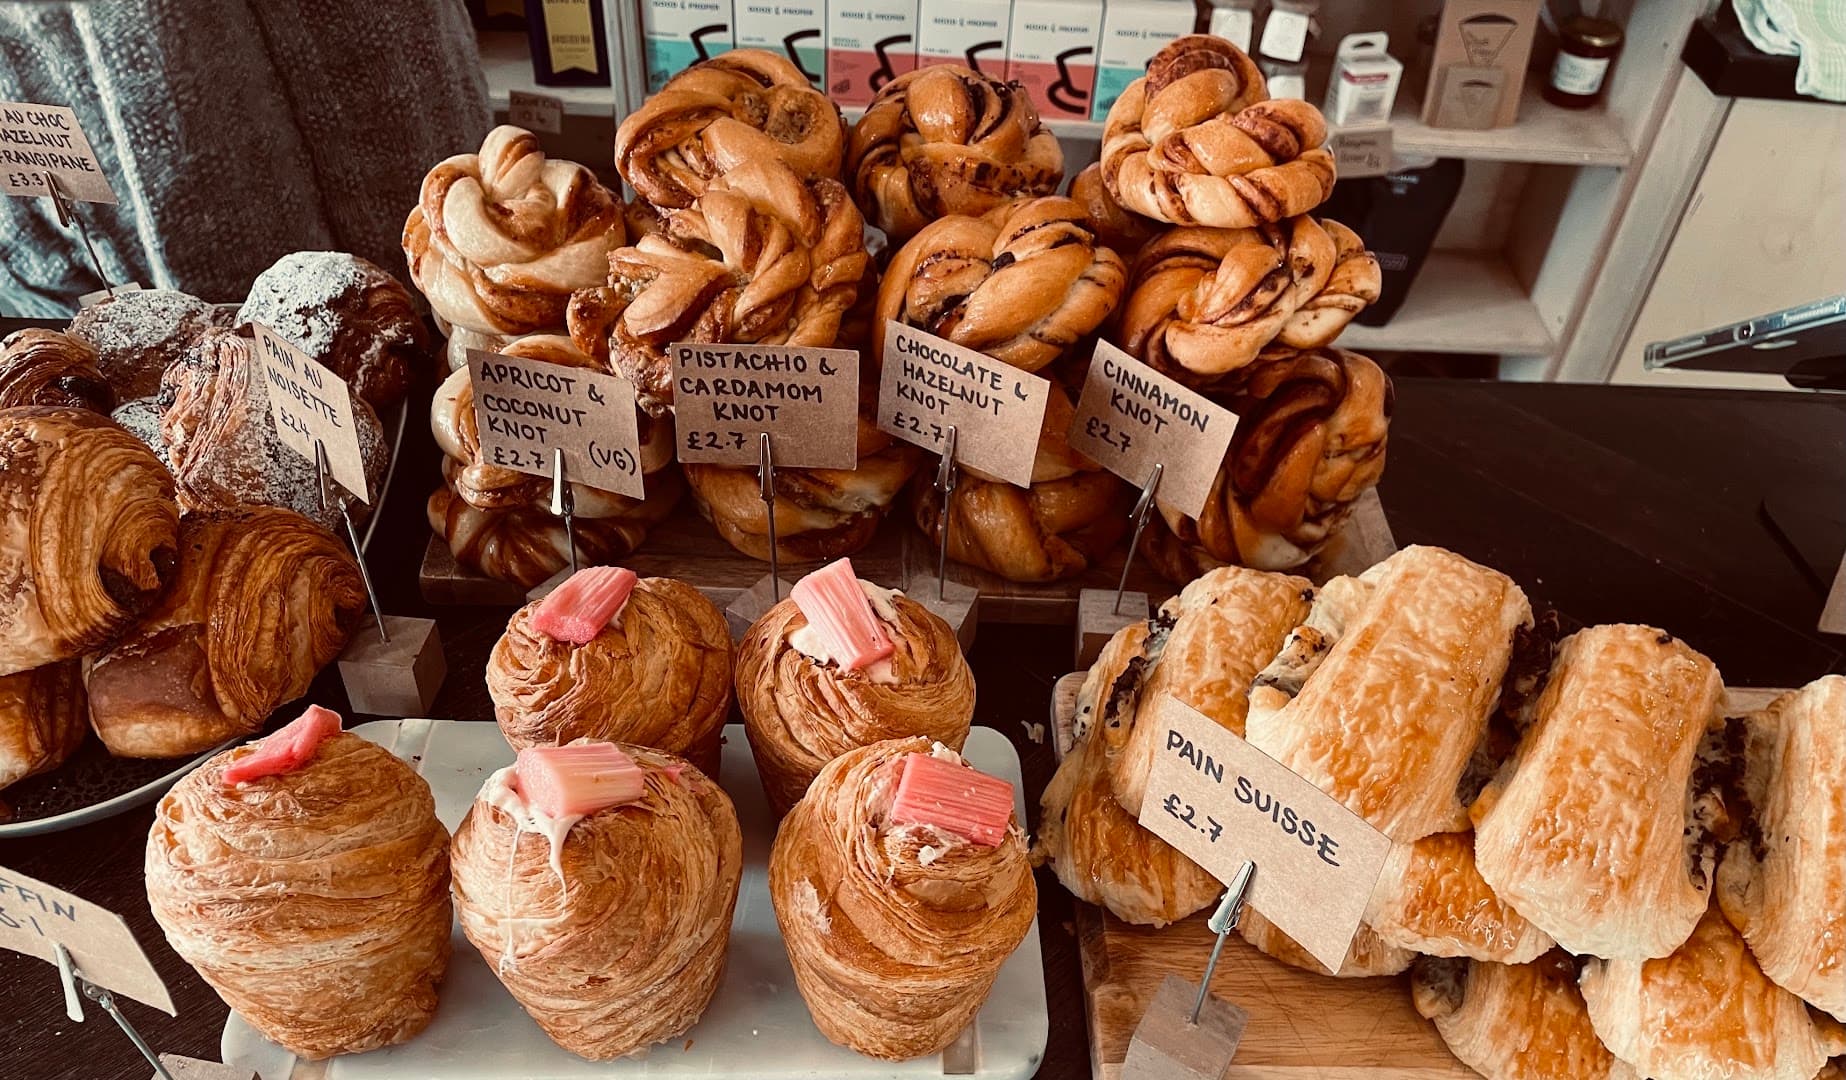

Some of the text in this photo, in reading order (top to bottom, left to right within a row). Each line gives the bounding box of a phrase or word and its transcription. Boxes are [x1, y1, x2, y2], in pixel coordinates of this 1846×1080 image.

[4, 108, 70, 130] AU CHOC
[263, 335, 323, 389] PAIN AU
[679, 348, 838, 375] PISTACHIO &
[896, 334, 1003, 391] CHOCOLATE
[267, 365, 342, 428] NOISETTE
[481, 361, 606, 406] APRICOT &
[679, 377, 823, 403] CARDAMOM
[896, 381, 950, 415] KNOT
[903, 360, 1005, 416] HAZELNUT
[1103, 359, 1210, 433] CINNAMON
[483, 393, 588, 427] COCONUT
[713, 401, 780, 422] KNOT
[893, 411, 945, 443] £2.7
[1110, 388, 1169, 434] KNOT
[487, 415, 548, 444] KNOT
[687, 431, 747, 450] £2.7
[494, 446, 546, 469] £2.7
[588, 440, 637, 476] (VG)
[1166, 729, 1340, 867] PAIN SUISSE
[1163, 793, 1224, 843] £2.7
